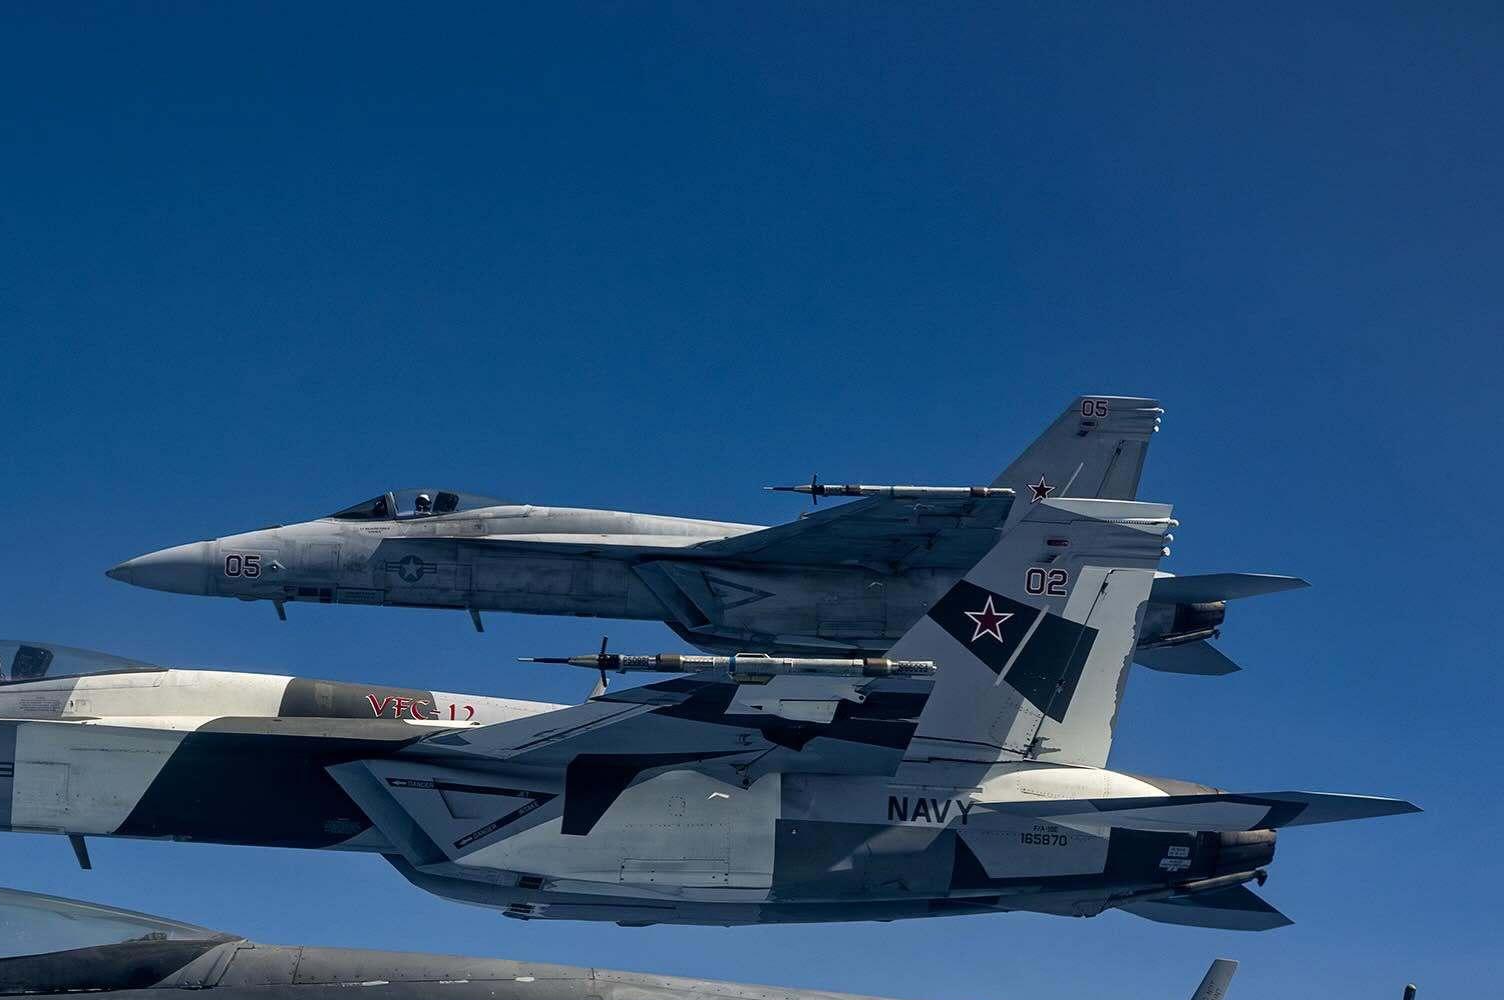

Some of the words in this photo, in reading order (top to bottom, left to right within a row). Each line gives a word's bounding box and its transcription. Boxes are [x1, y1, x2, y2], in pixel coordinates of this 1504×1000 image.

[1081, 400, 1108, 417] 05
[224, 554, 262, 578] 05
[1024, 567, 1069, 596] 02
[366, 694, 475, 720] VFC-12
[887, 796, 975, 825] NAVY
[1020, 832, 1067, 846] 165870
